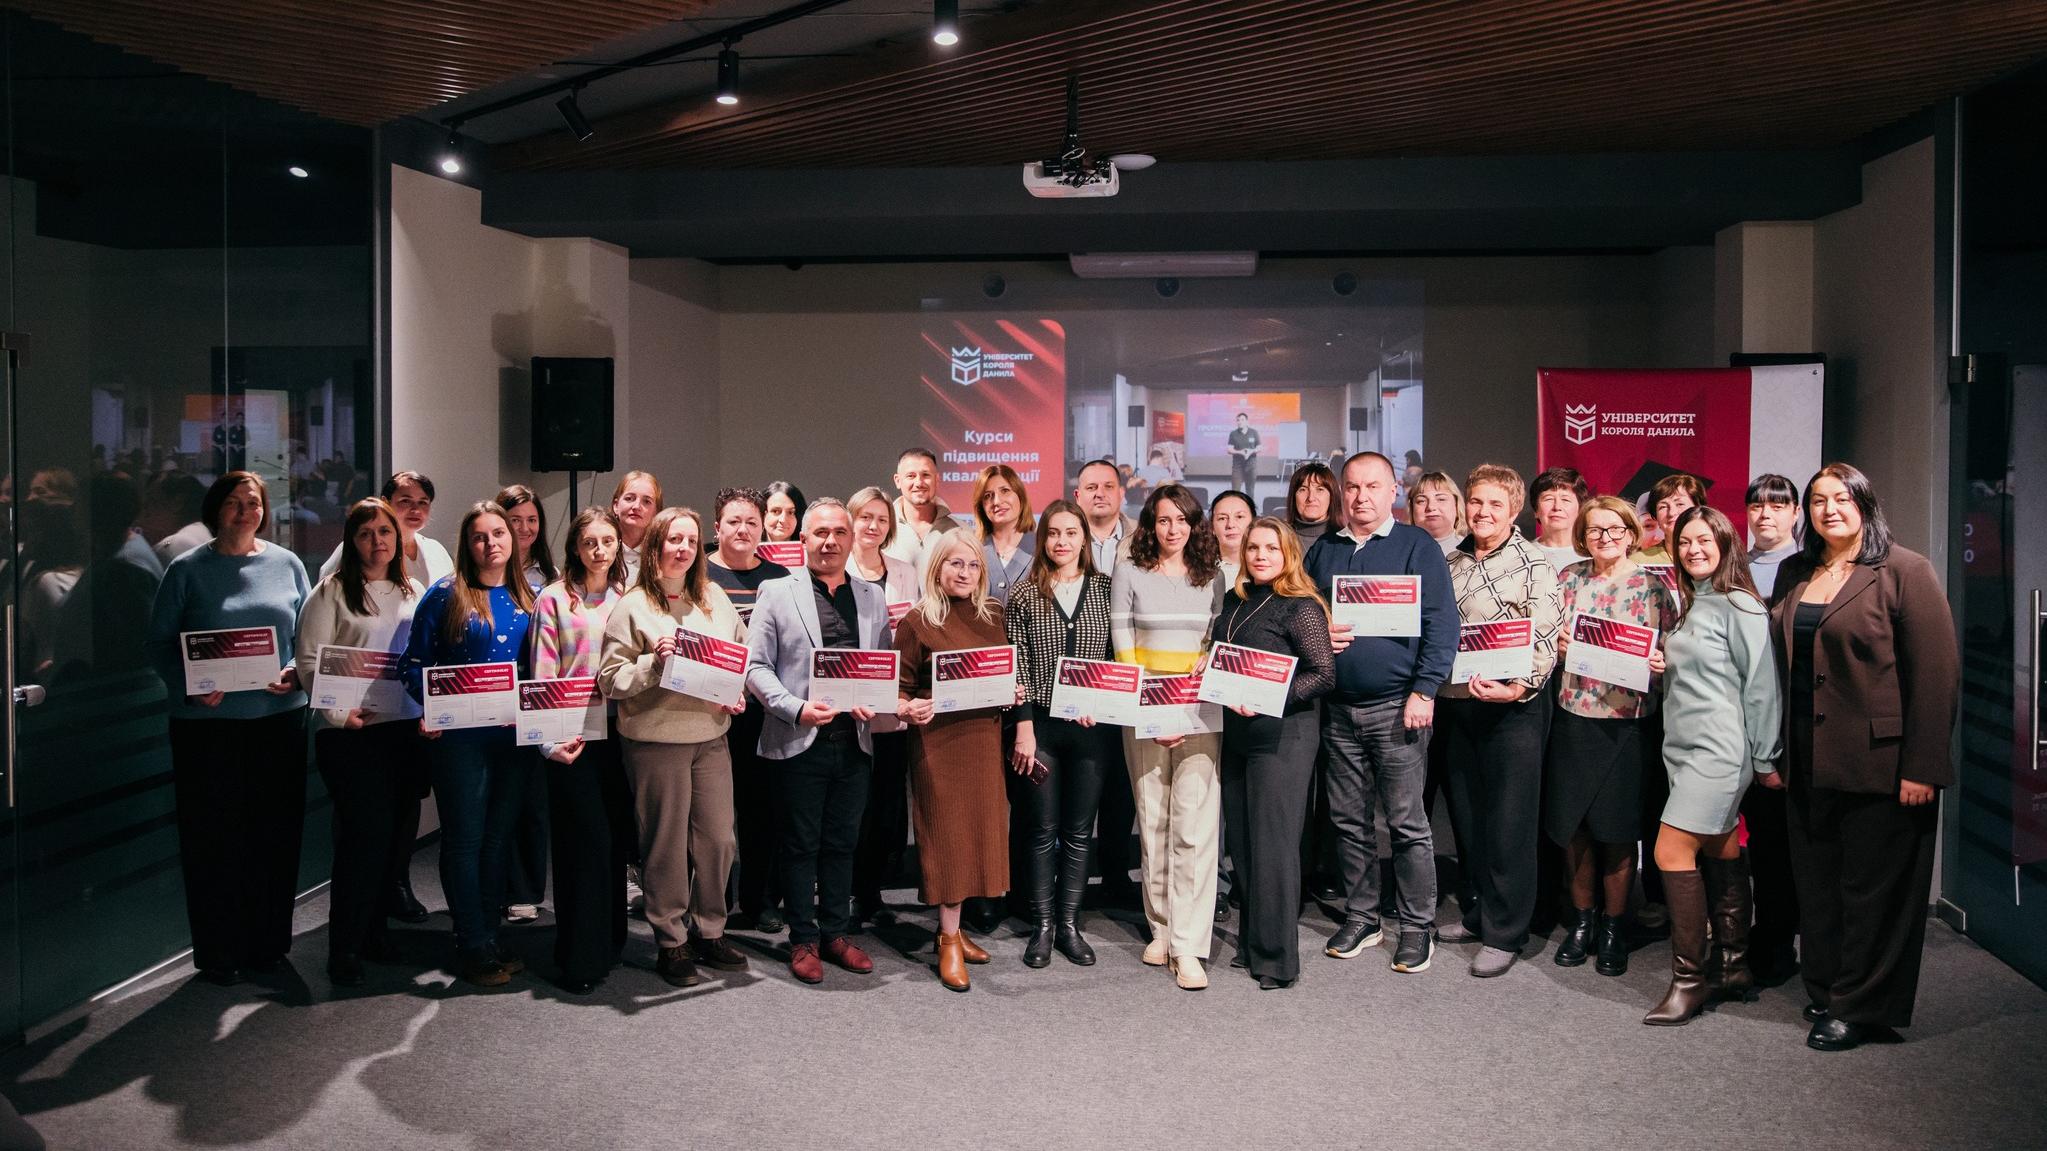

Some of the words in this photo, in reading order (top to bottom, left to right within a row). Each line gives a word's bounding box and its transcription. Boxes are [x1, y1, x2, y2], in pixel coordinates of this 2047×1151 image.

[1601, 413, 1696, 423] УНІВЕРСИТЕТ
[964, 430, 1014, 444] Курси
[1601, 427, 1644, 436] КОРОЛЯ
[1647, 427, 1695, 436] ДАНИЛА
[943, 450, 1039, 463] підвищення
